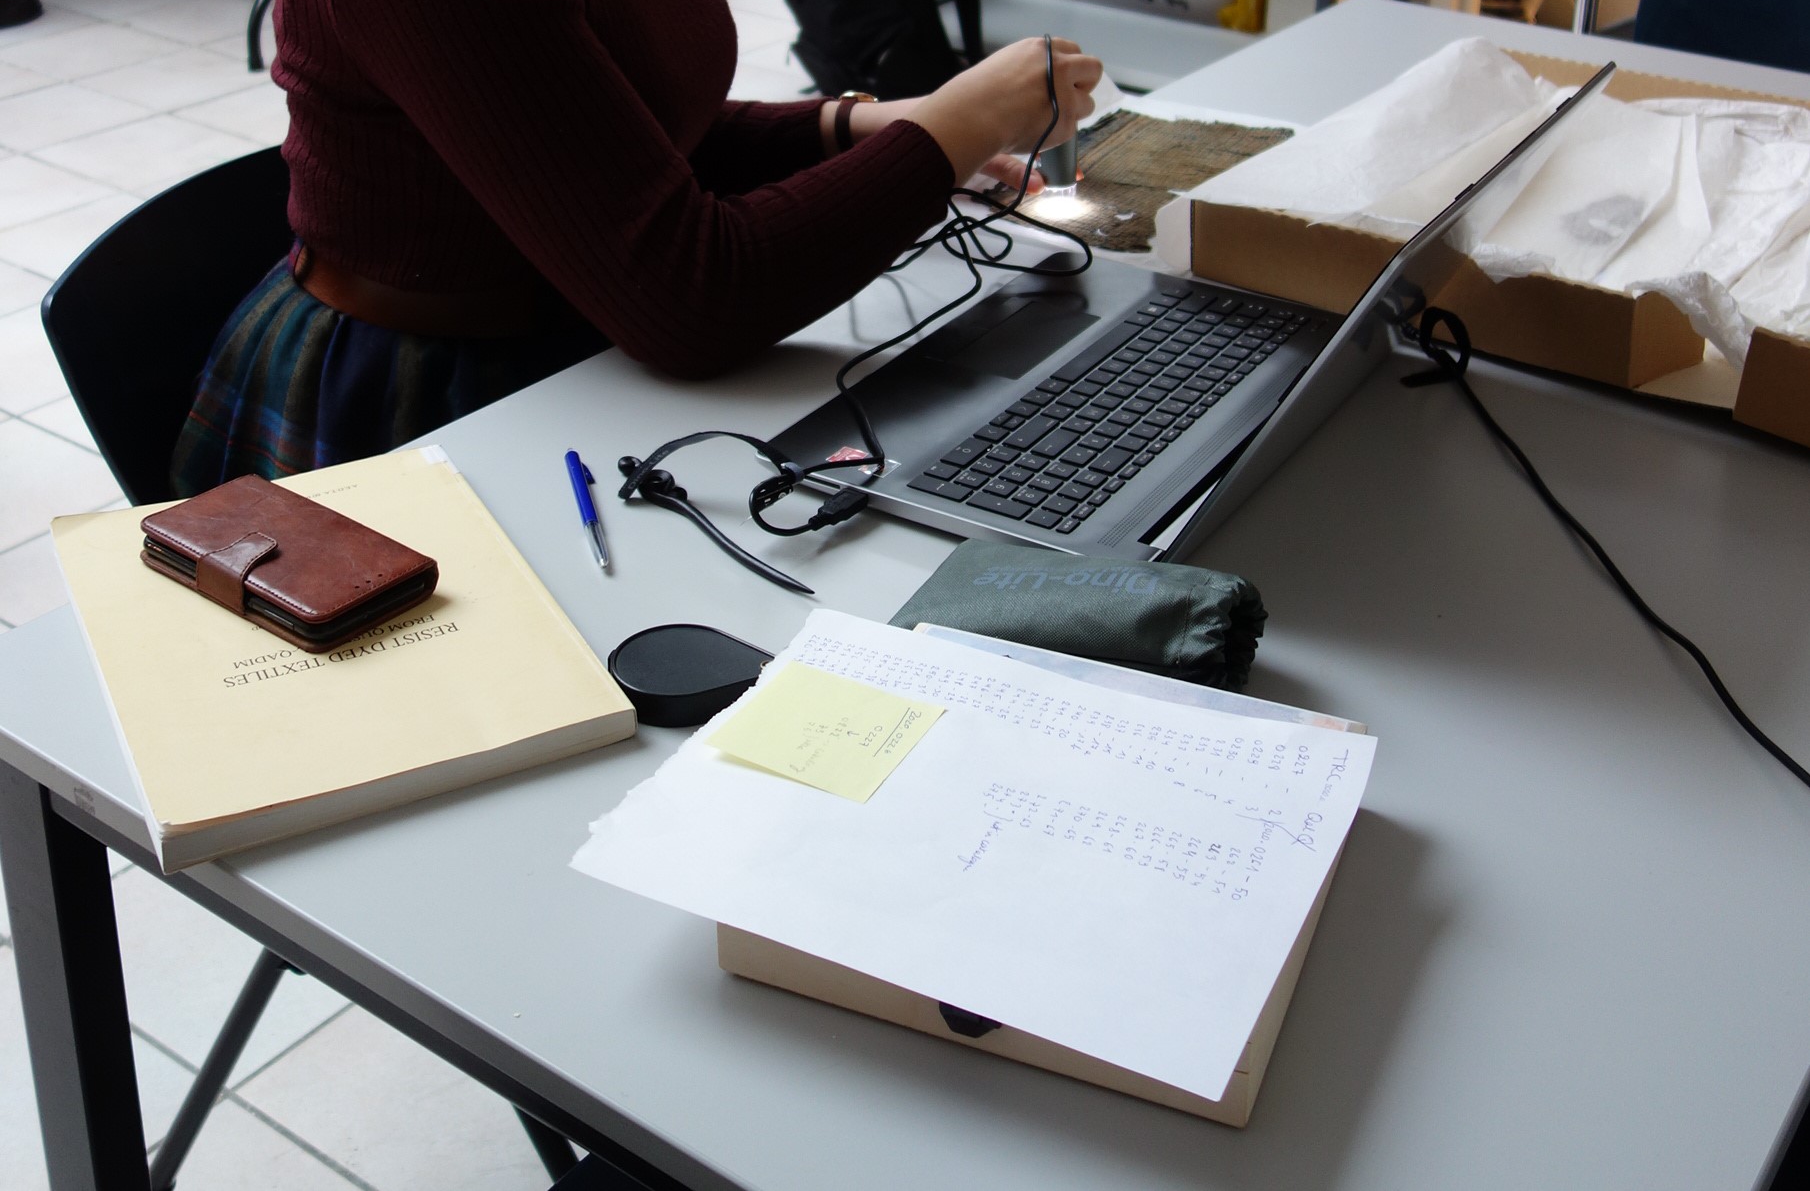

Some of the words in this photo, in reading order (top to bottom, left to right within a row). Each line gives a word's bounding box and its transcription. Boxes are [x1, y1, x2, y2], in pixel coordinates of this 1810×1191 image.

[973, 563, 1161, 594] Dino-Lite
[387, 613, 435, 633] FROM
[392, 621, 459, 648] RESIST
[328, 641, 387, 664] DYED
[222, 658, 326, 689] TEXTILES
